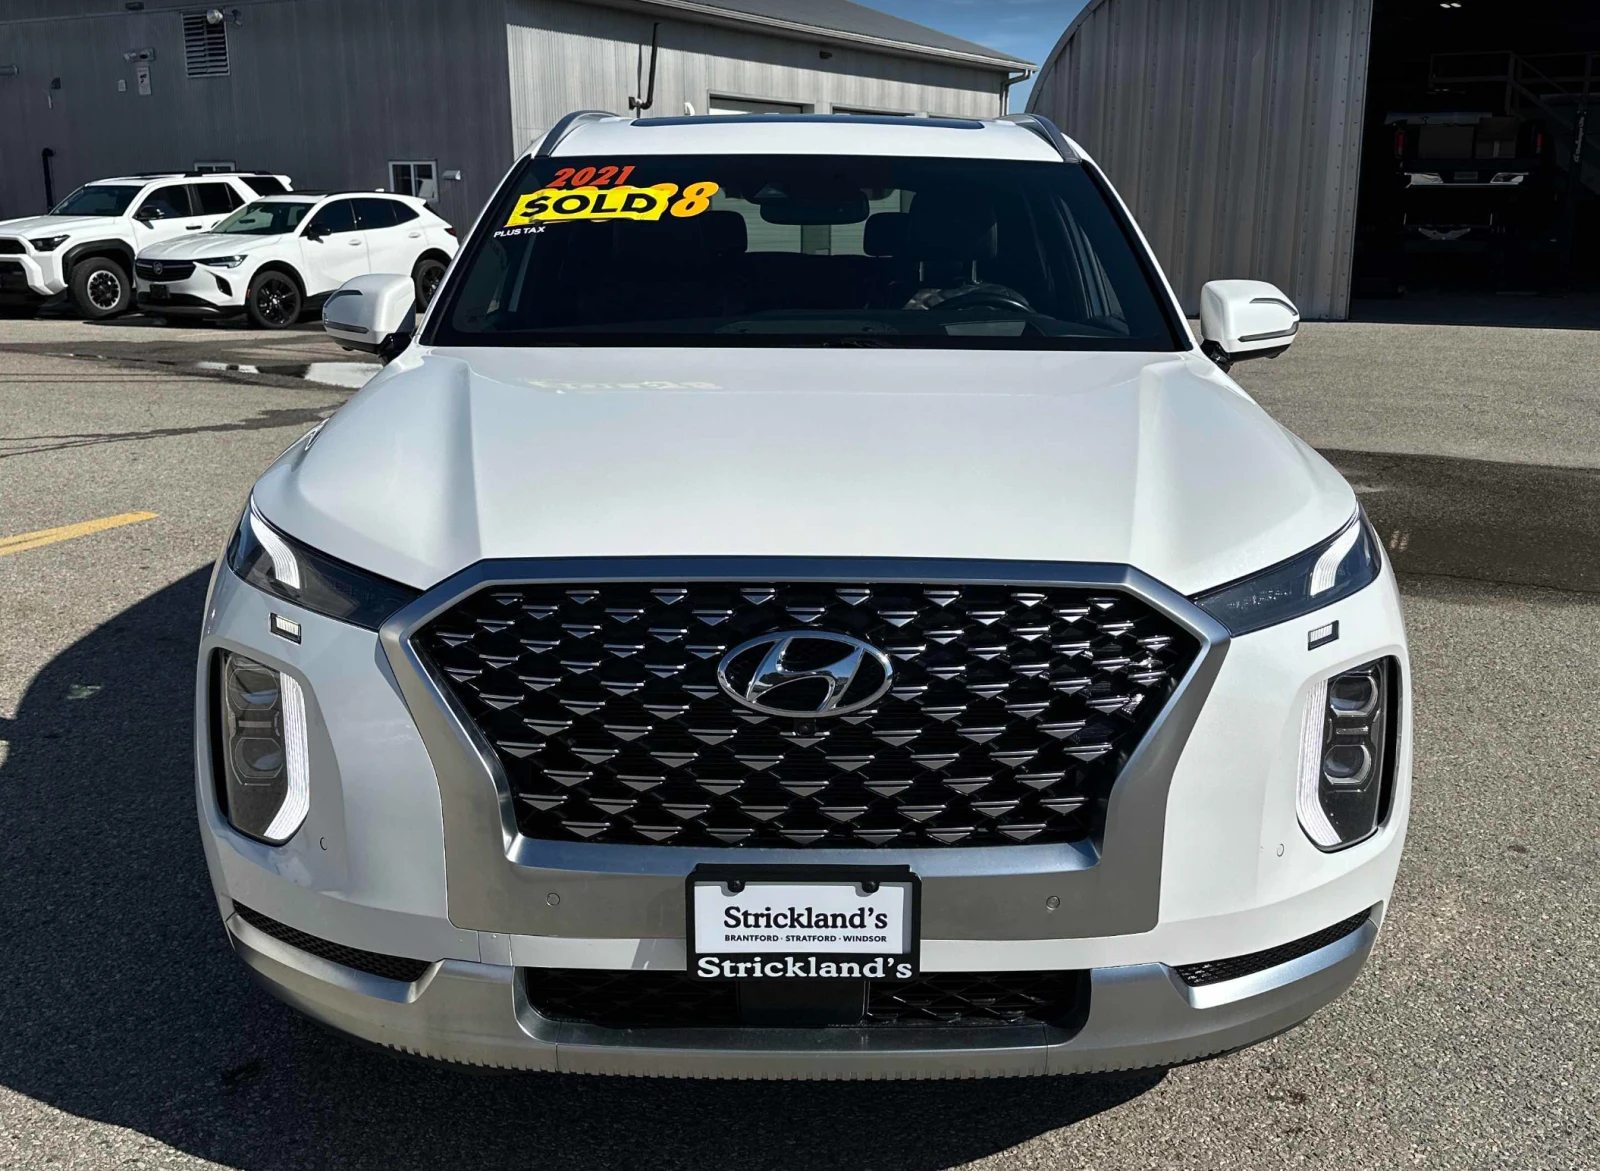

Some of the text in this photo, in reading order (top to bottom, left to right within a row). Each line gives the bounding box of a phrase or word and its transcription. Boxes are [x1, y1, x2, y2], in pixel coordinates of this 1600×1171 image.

[546, 165, 636, 188] 2021
[520, 192, 658, 218] SOLD
[493, 226, 546, 238] PLUS TAX
[723, 906, 888, 929] Strickland's
[724, 934, 779, 942] BRANTFORD
[785, 934, 837, 942] STRATFORD
[697, 956, 913, 979] Strickland's
